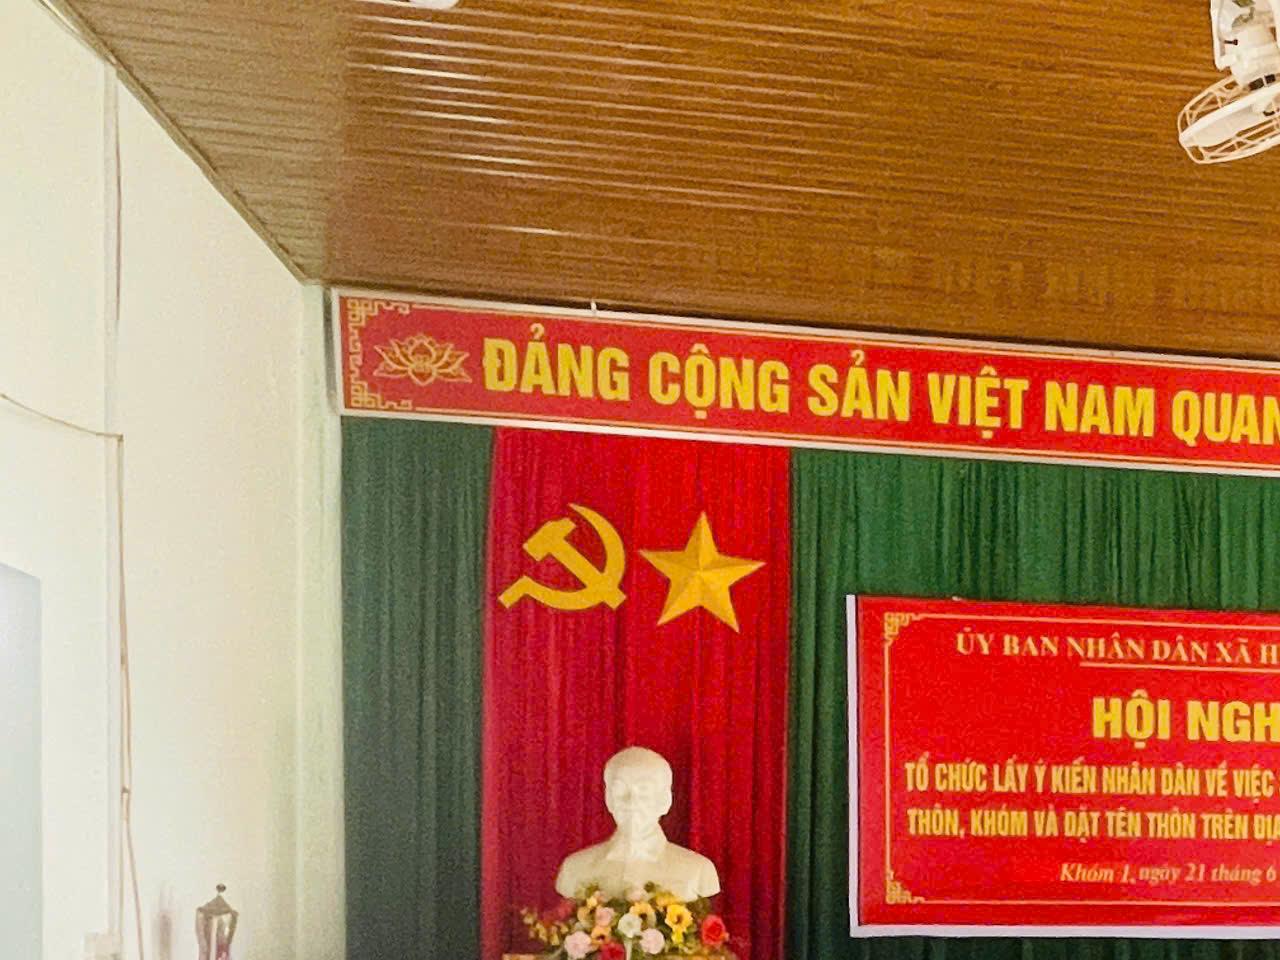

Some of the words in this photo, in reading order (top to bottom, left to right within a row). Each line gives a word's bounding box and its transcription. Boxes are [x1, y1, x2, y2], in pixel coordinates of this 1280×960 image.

[482, 322, 631, 401] ĐẢNG
[649, 343, 790, 420] CỘNG
[807, 349, 911, 422] SẢN
[927, 365, 1030, 440] VIỆT
[1045, 380, 1156, 438] NAM
[956, 627, 995, 656] ỦY
[1003, 634, 1059, 658] BAN
[1066, 632, 1146, 660] NHÂN
[1152, 634, 1208, 663] DÂN
[1216, 637, 1251, 665] XÃ
[1092, 688, 1171, 750] HỘI
[904, 751, 931, 793] TỔ
[934, 757, 989, 793] CHỨC
[993, 754, 1030, 794] LẤY
[1033, 758, 1048, 794] Ý
[1051, 756, 1098, 795] KIẾN
[1102, 760, 1157, 796] NHÂN
[1160, 761, 1201, 797] DÂN
[1204, 759, 1228, 798] VỀ
[1233, 763, 1276, 804] VIỆC
[907, 802, 966, 839] THÔN,
[971, 802, 1029, 838] KHÓM
[1033, 802, 1060, 838] VÀ
[1105, 805, 1143, 839] TÊN
[1147, 805, 1197, 840] THÔN
[1201, 807, 1249, 841] TRÊN
[1060, 862, 1115, 883] Khóm
[1138, 865, 1183, 886] ngày
[1184, 862, 1207, 883] 21
[1210, 863, 1264, 887] tháng
[1265, 865, 1277, 883] 6
